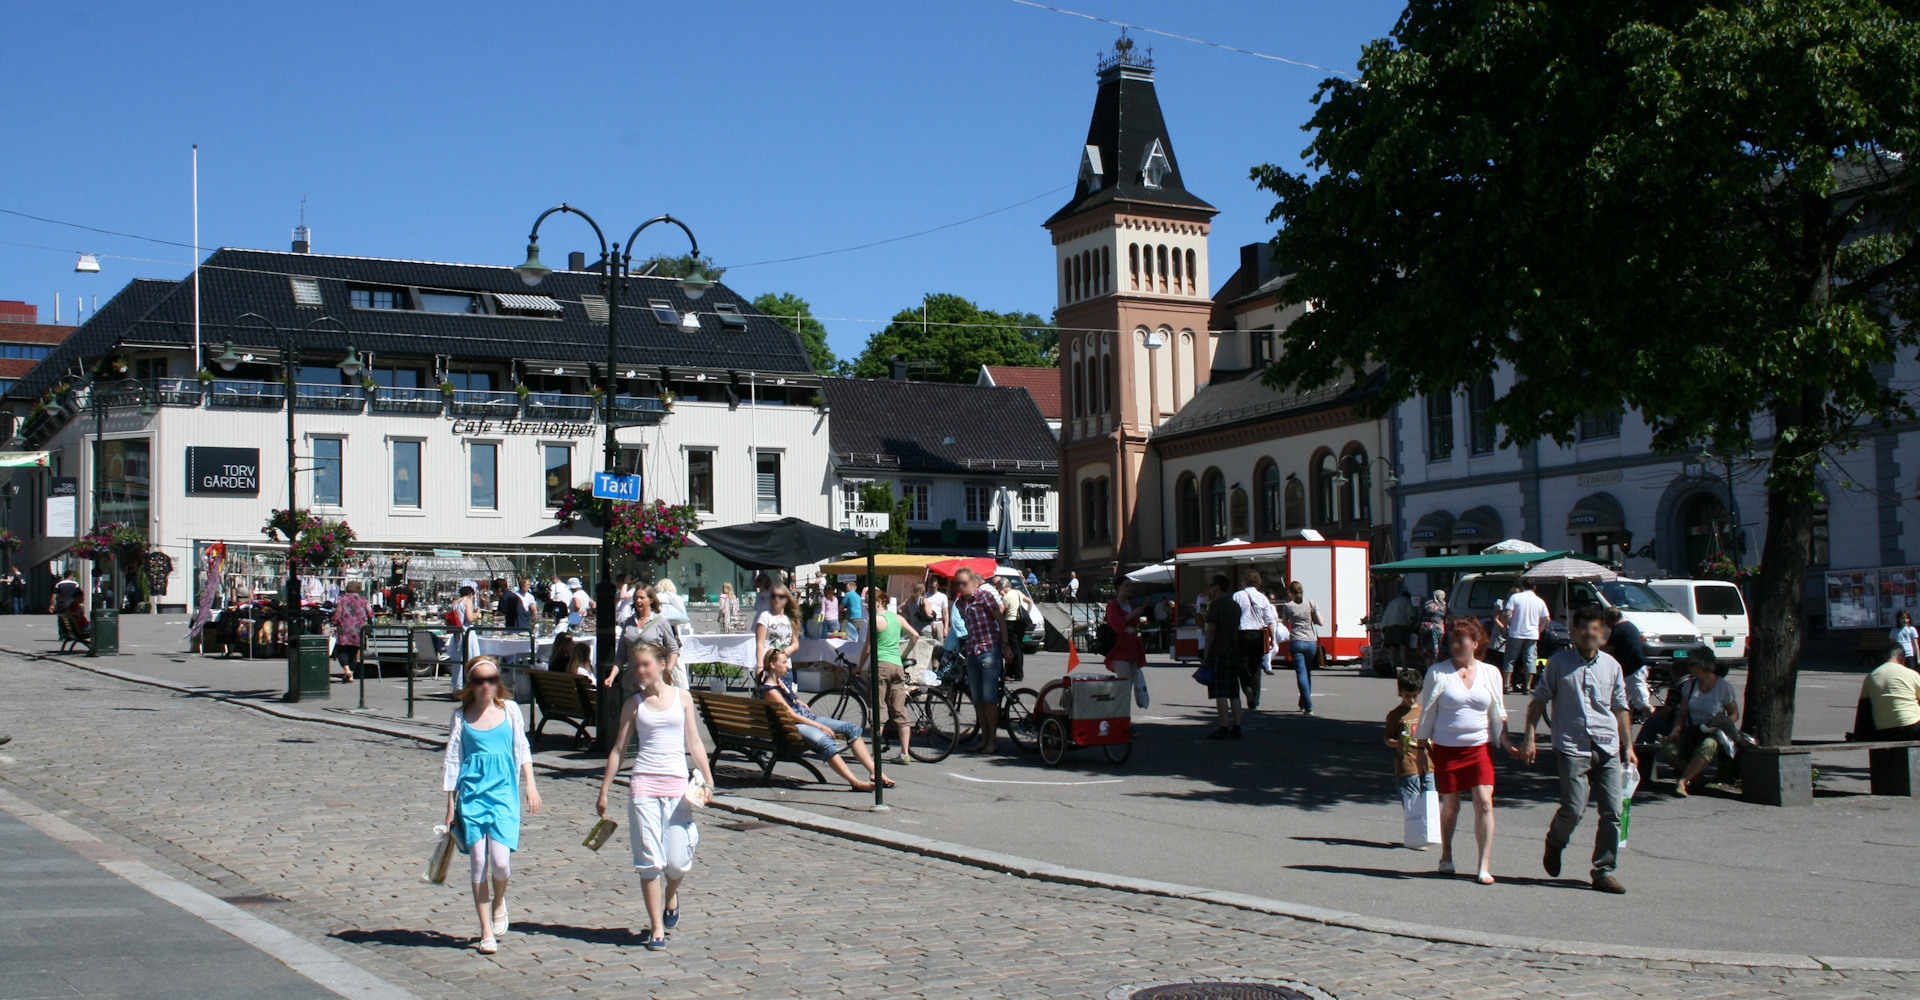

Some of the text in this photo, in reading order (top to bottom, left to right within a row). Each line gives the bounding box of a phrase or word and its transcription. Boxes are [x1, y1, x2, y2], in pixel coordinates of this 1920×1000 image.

[500, 417, 597, 439] Torvtoppen
[223, 464, 255, 477] TORV
[203, 474, 256, 489] GÅRDEN
[600, 476, 633, 495] Taxi
[856, 515, 878, 528] Maxi
